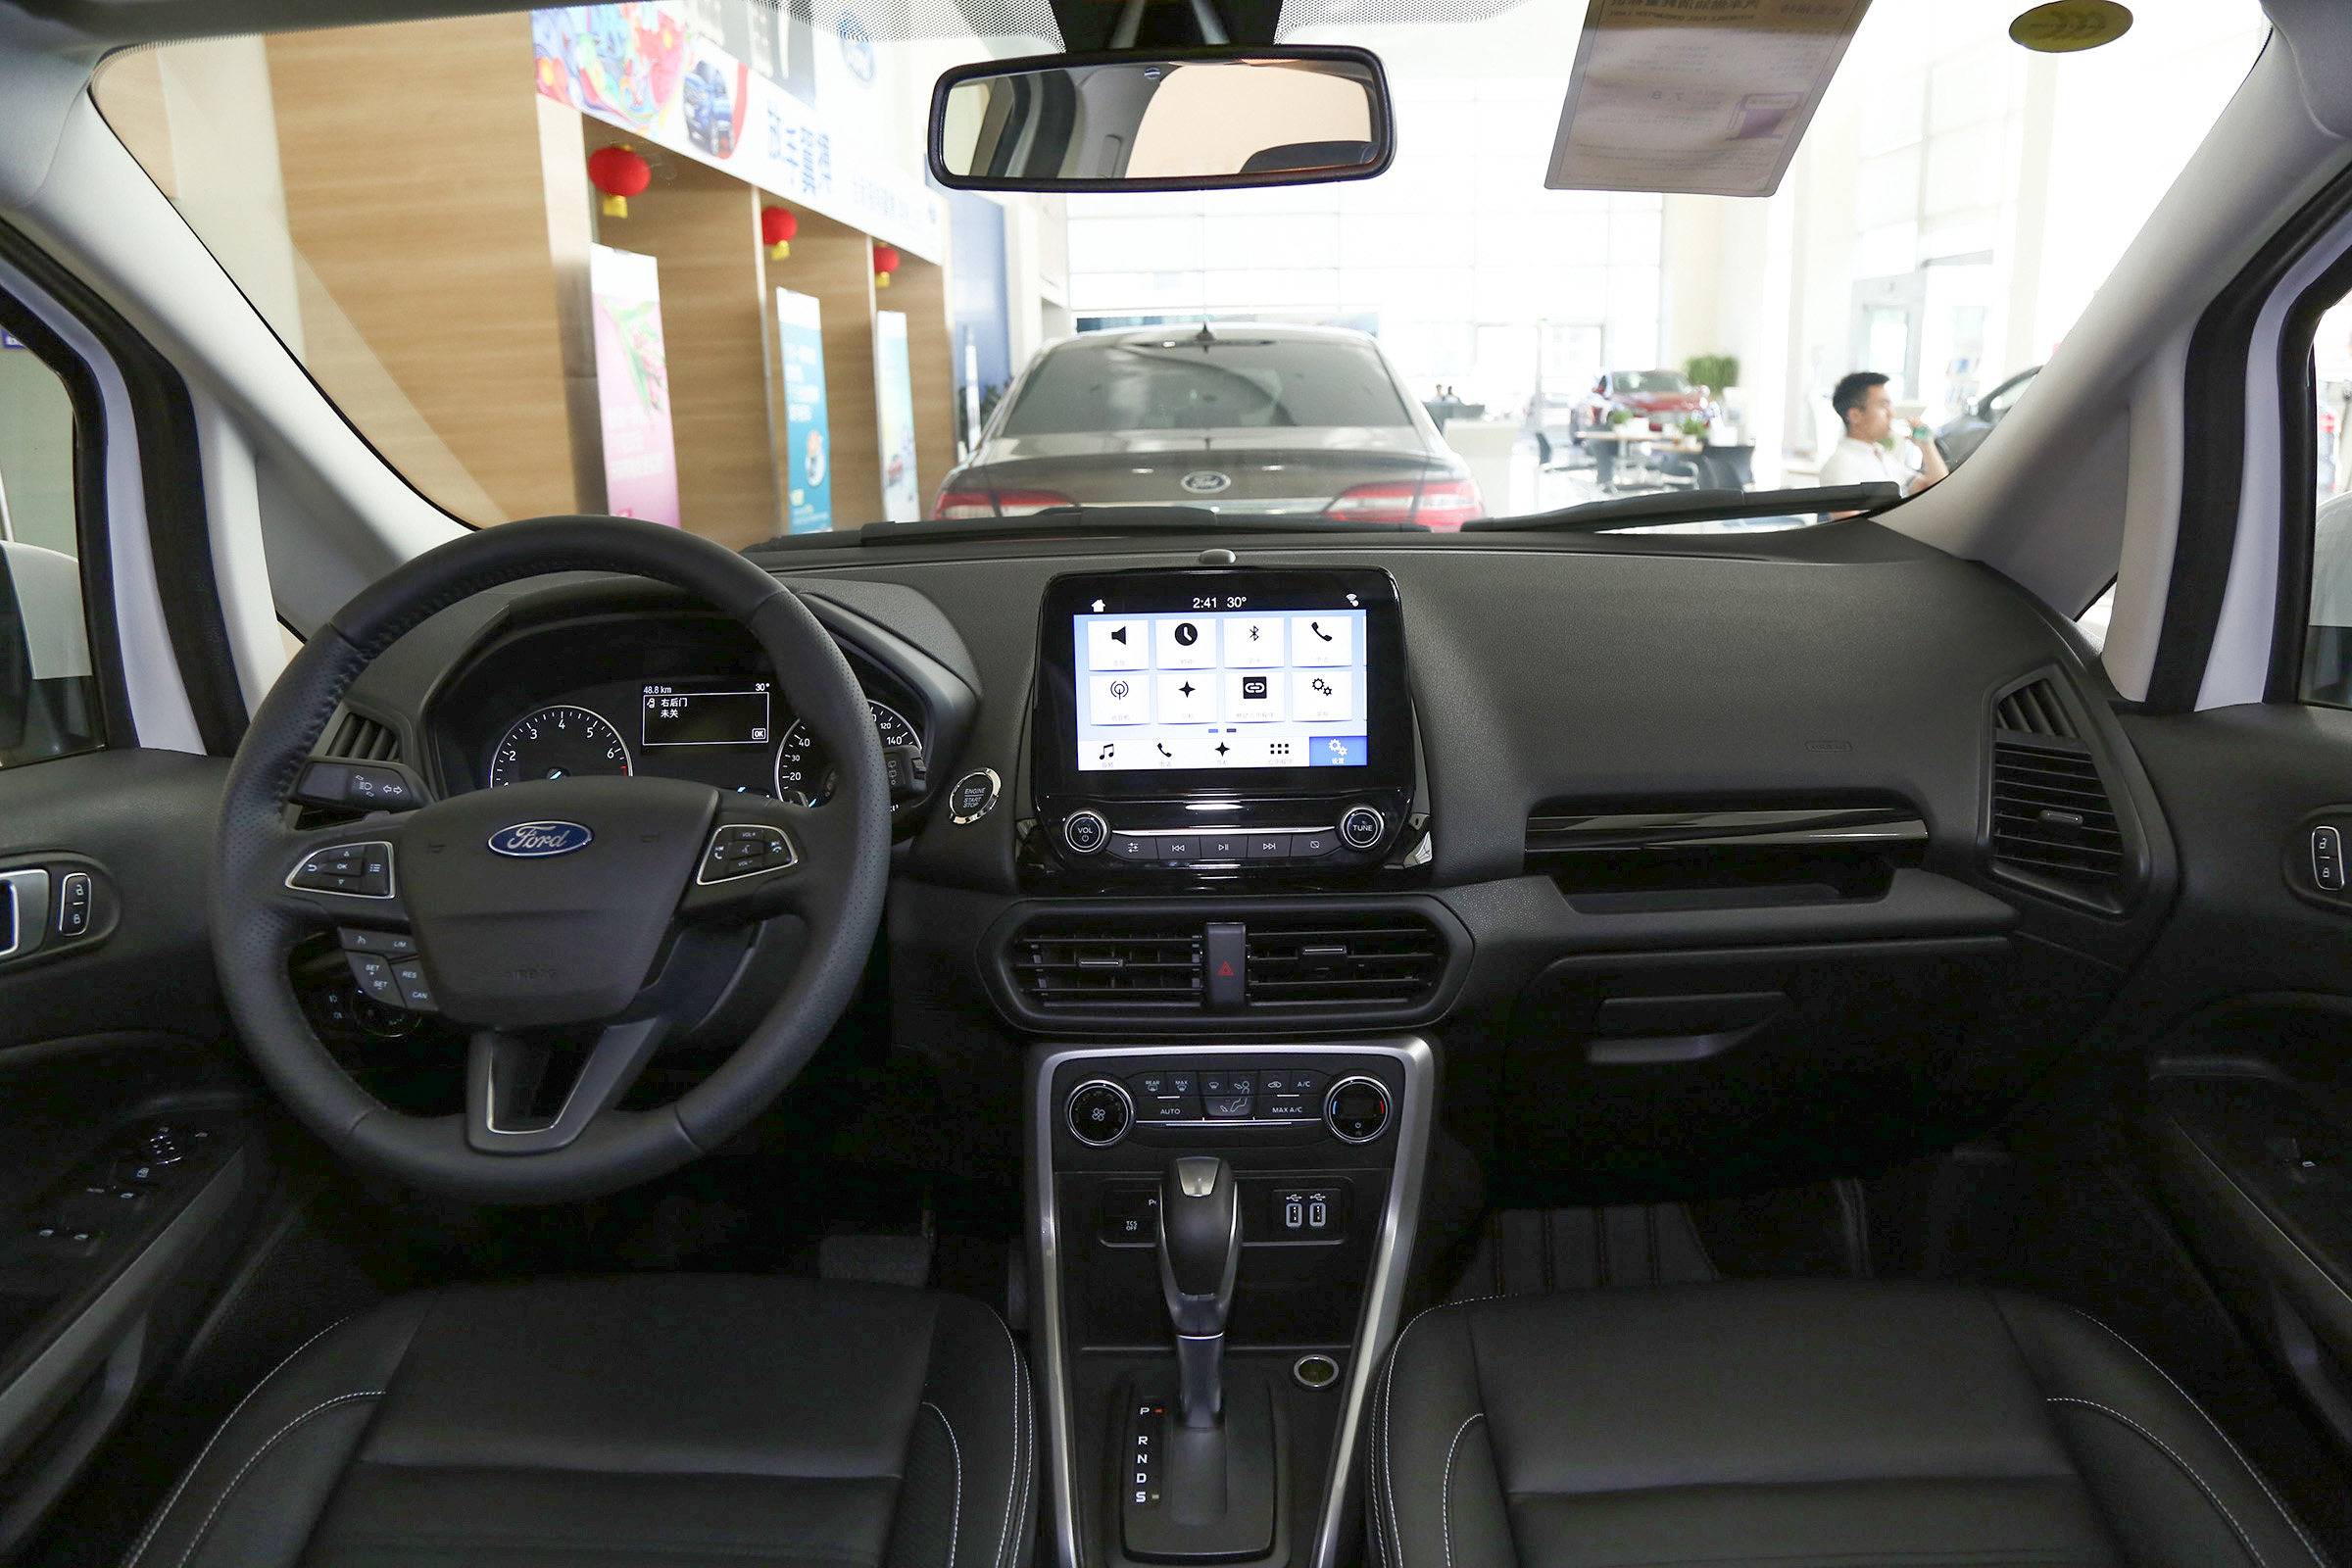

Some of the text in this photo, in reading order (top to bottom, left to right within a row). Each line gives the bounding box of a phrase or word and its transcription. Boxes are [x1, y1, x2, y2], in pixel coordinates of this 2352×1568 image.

[1192, 596, 1248, 609] 2:41 30°
[643, 685, 660, 694] 48.8
[661, 697, 688, 708] 右后门
[660, 709, 679, 718] 未关
[558, 718, 566, 730] 4
[529, 728, 538, 741] 3
[586, 726, 594, 739] 5
[798, 738, 810, 748] 40
[886, 736, 903, 746] 140
[509, 750, 517, 762] 2
[606, 747, 614, 760] 6
[789, 772, 802, 781] 20
[507, 825, 571, 850] Ford
[402, 970, 417, 979] RES
[412, 991, 428, 1000] CAN
[1138, 1436, 1149, 1446] R
[1137, 1453, 1148, 1464] N
[1136, 1472, 1147, 1484] D
[1135, 1491, 1147, 1503] S
